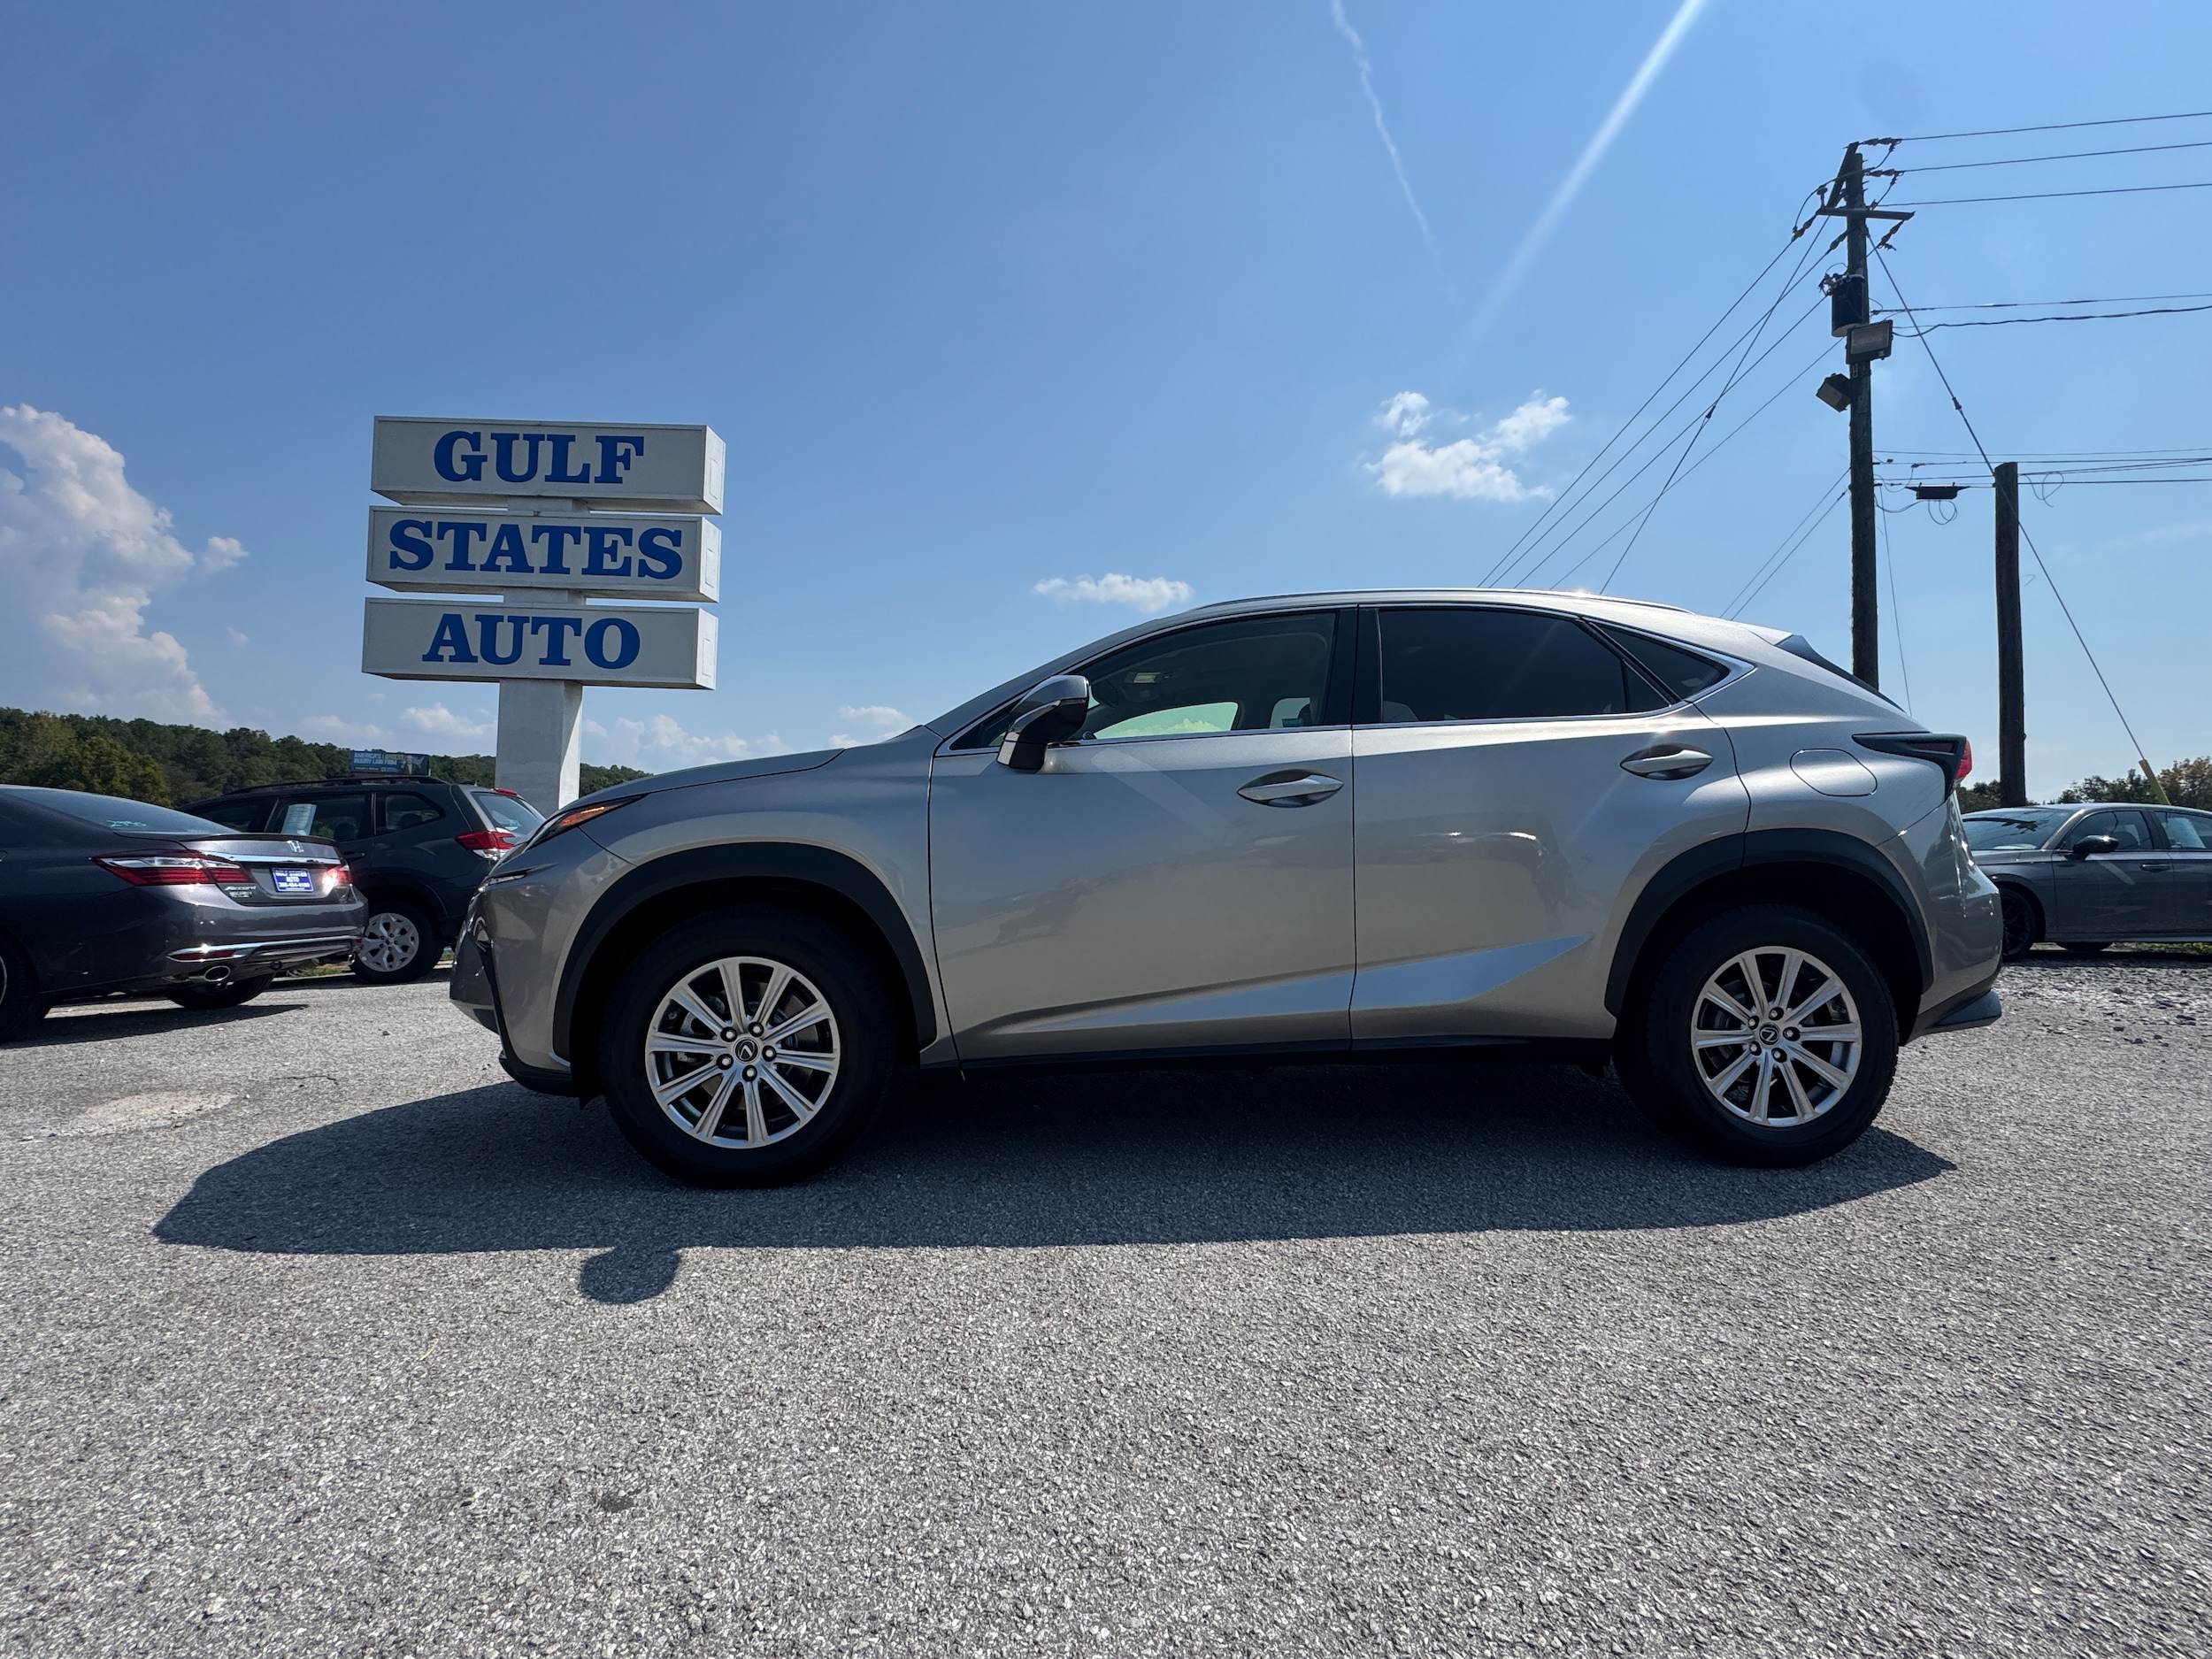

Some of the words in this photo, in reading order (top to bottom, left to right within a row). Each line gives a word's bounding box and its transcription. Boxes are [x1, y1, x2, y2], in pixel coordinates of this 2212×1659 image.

[434, 431, 645, 485] GULF
[388, 519, 683, 580] STATES
[421, 613, 641, 670] AUTO
